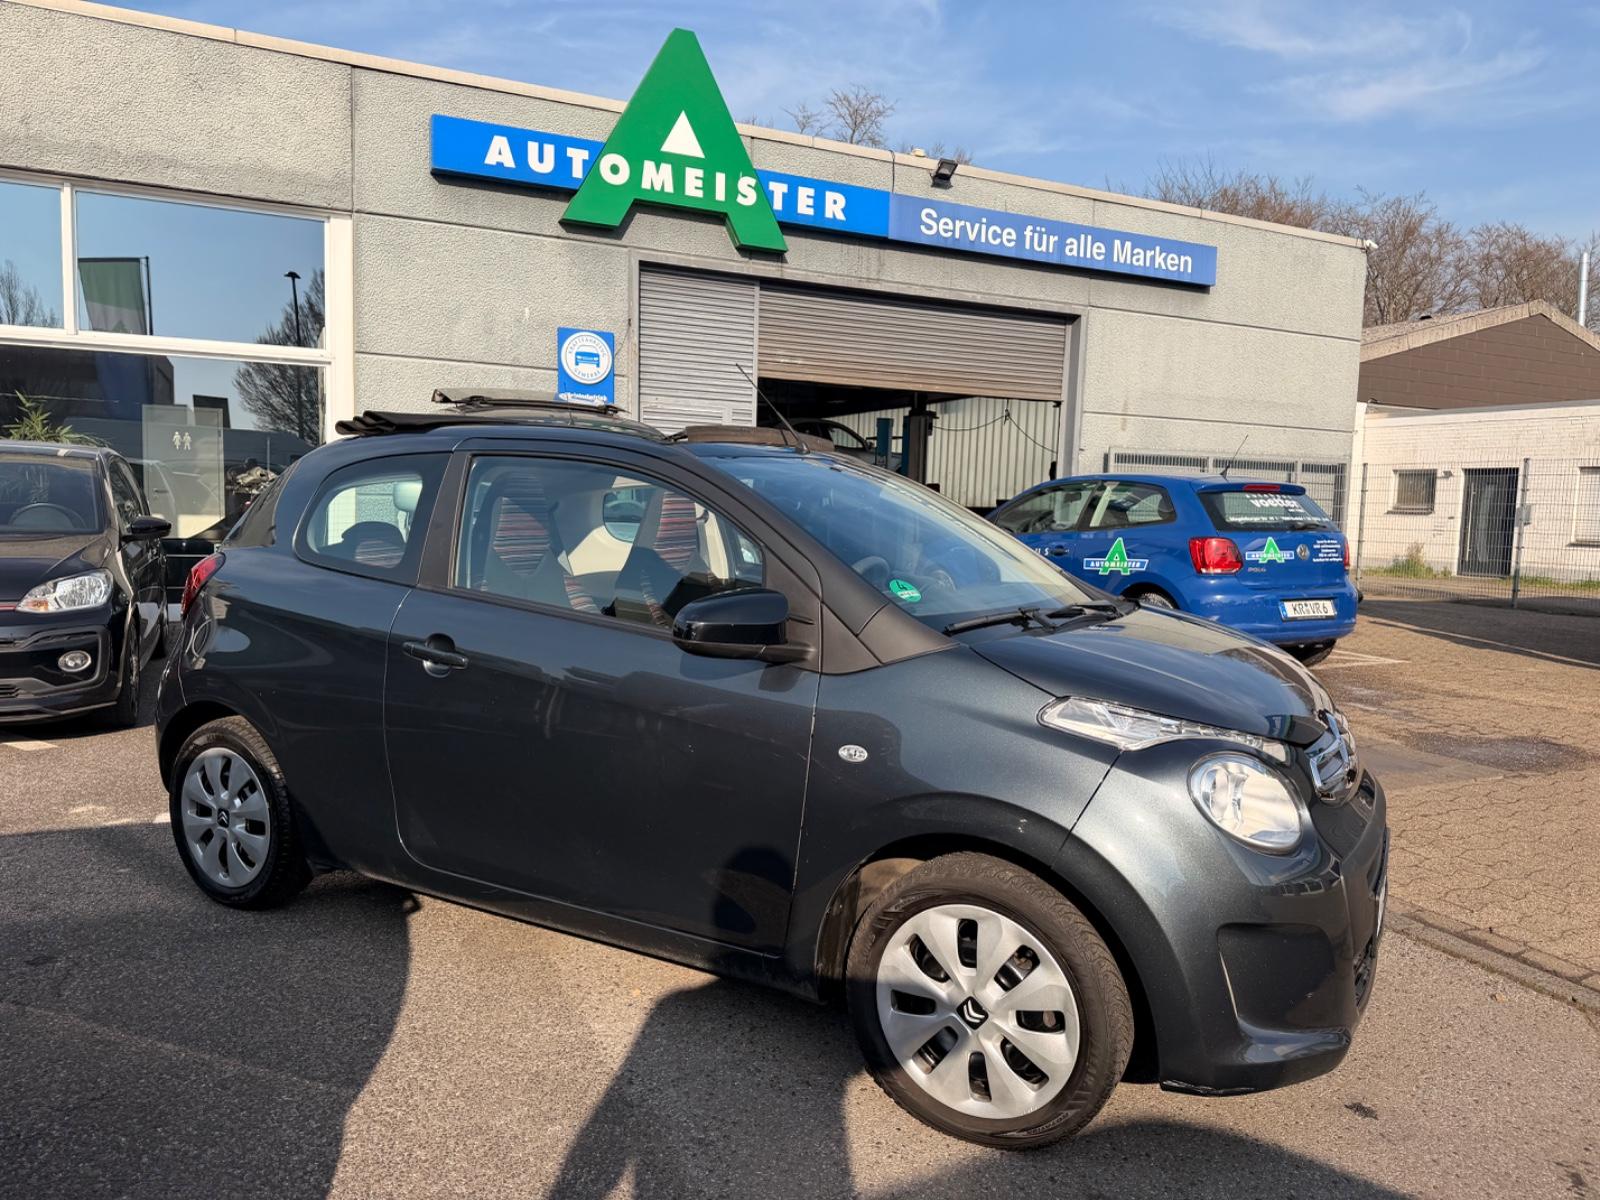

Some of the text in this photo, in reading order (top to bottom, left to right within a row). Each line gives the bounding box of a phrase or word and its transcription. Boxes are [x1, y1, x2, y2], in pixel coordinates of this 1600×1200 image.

[484, 135, 847, 222] AUTOMEISTER
[919, 207, 1193, 273] Service für alle Marken
[1089, 560, 1141, 568] AUTOMEISTER
